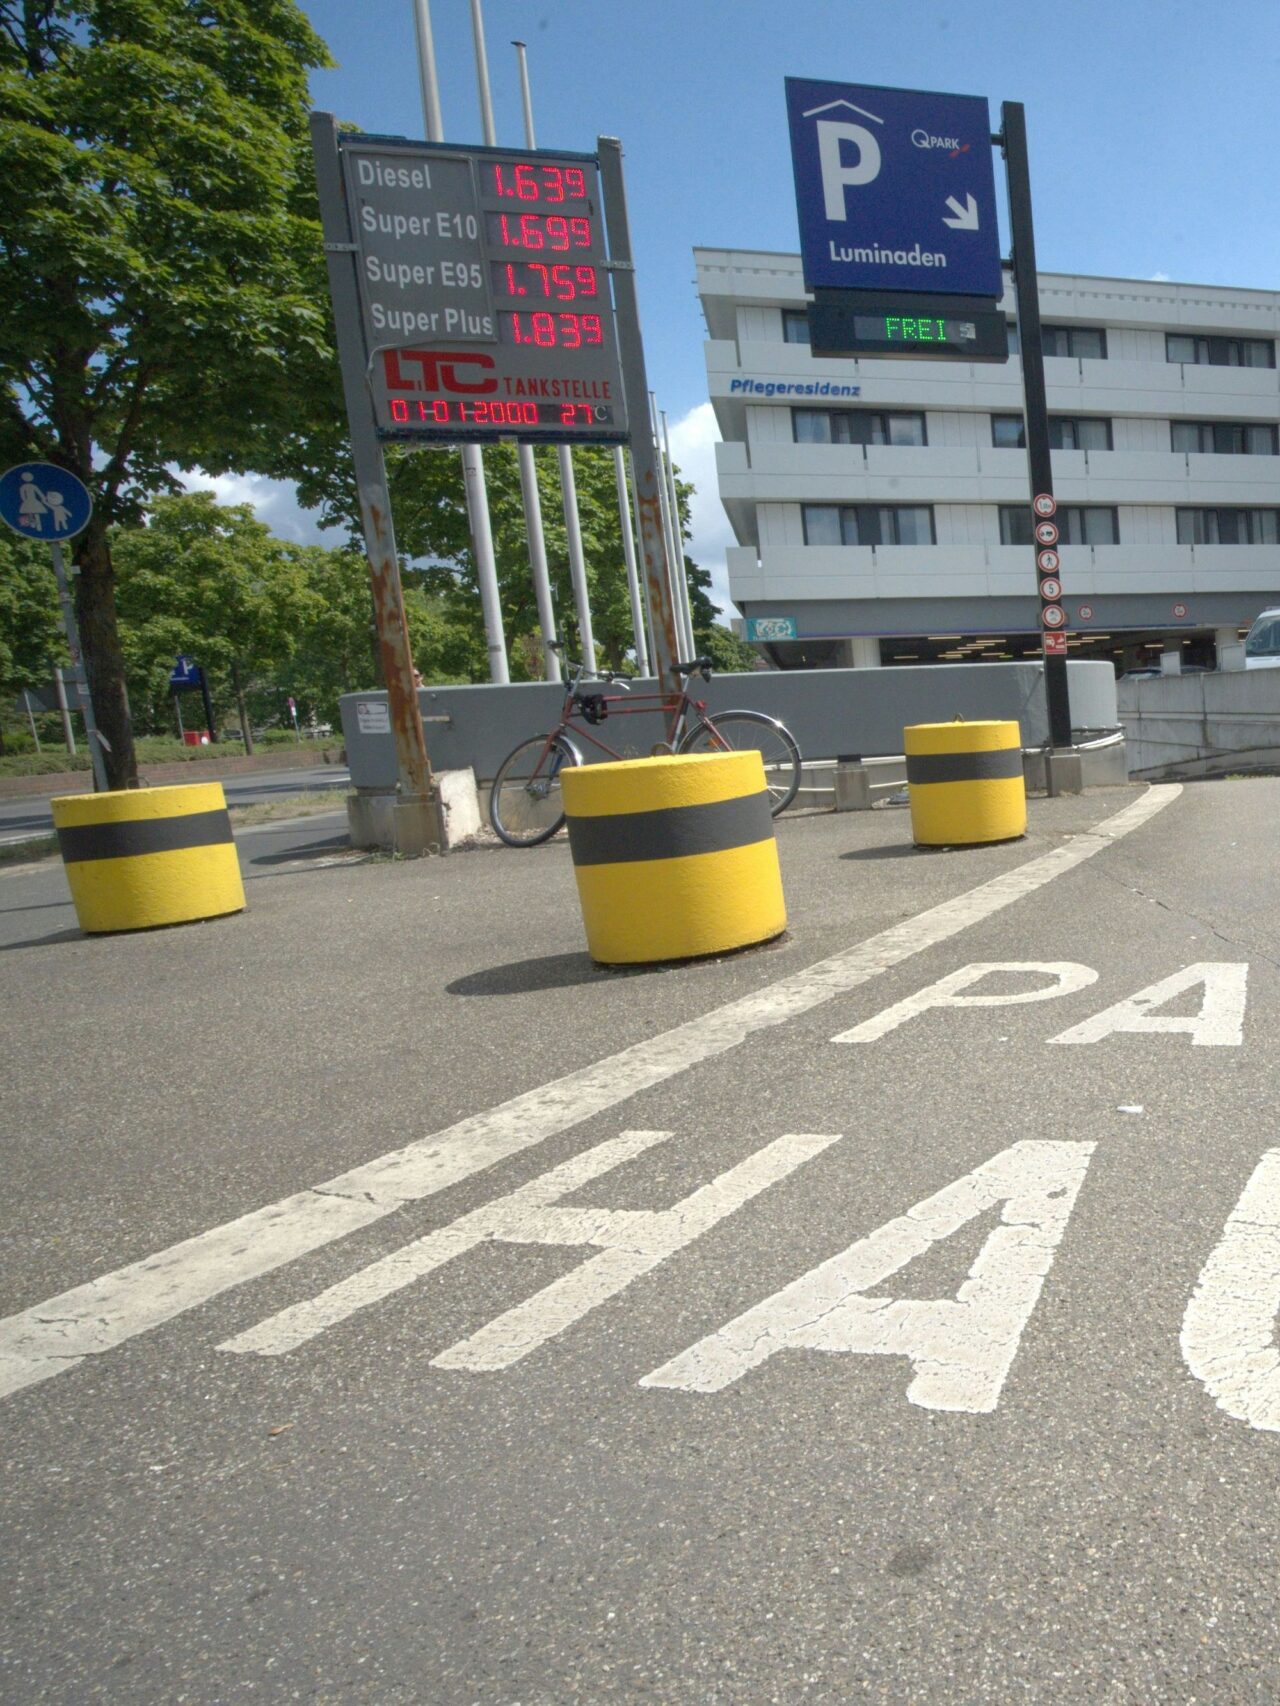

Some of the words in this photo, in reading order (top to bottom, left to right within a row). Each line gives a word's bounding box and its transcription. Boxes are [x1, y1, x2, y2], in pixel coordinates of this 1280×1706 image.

[357, 159, 432, 190] Diesel
[494, 163, 587, 203] 1.639
[816, 120, 881, 222] P
[360, 205, 431, 240] Super
[435, 212, 478, 240] E10
[500, 213, 592, 251] 1.699
[829, 240, 947, 268] Luminaden
[365, 256, 435, 289] Super
[440, 261, 483, 289] E95
[505, 262, 597, 301] 1.759
[370, 303, 439, 336] Super
[444, 308, 494, 336] Plus
[511, 311, 603, 348] 1.839
[885, 316, 947, 342] FREI
[502, 376, 613, 400] TANKSTELLE
[730, 378, 862, 398] Pflegeresidenz
[1048, 583, 1055, 595] 5
